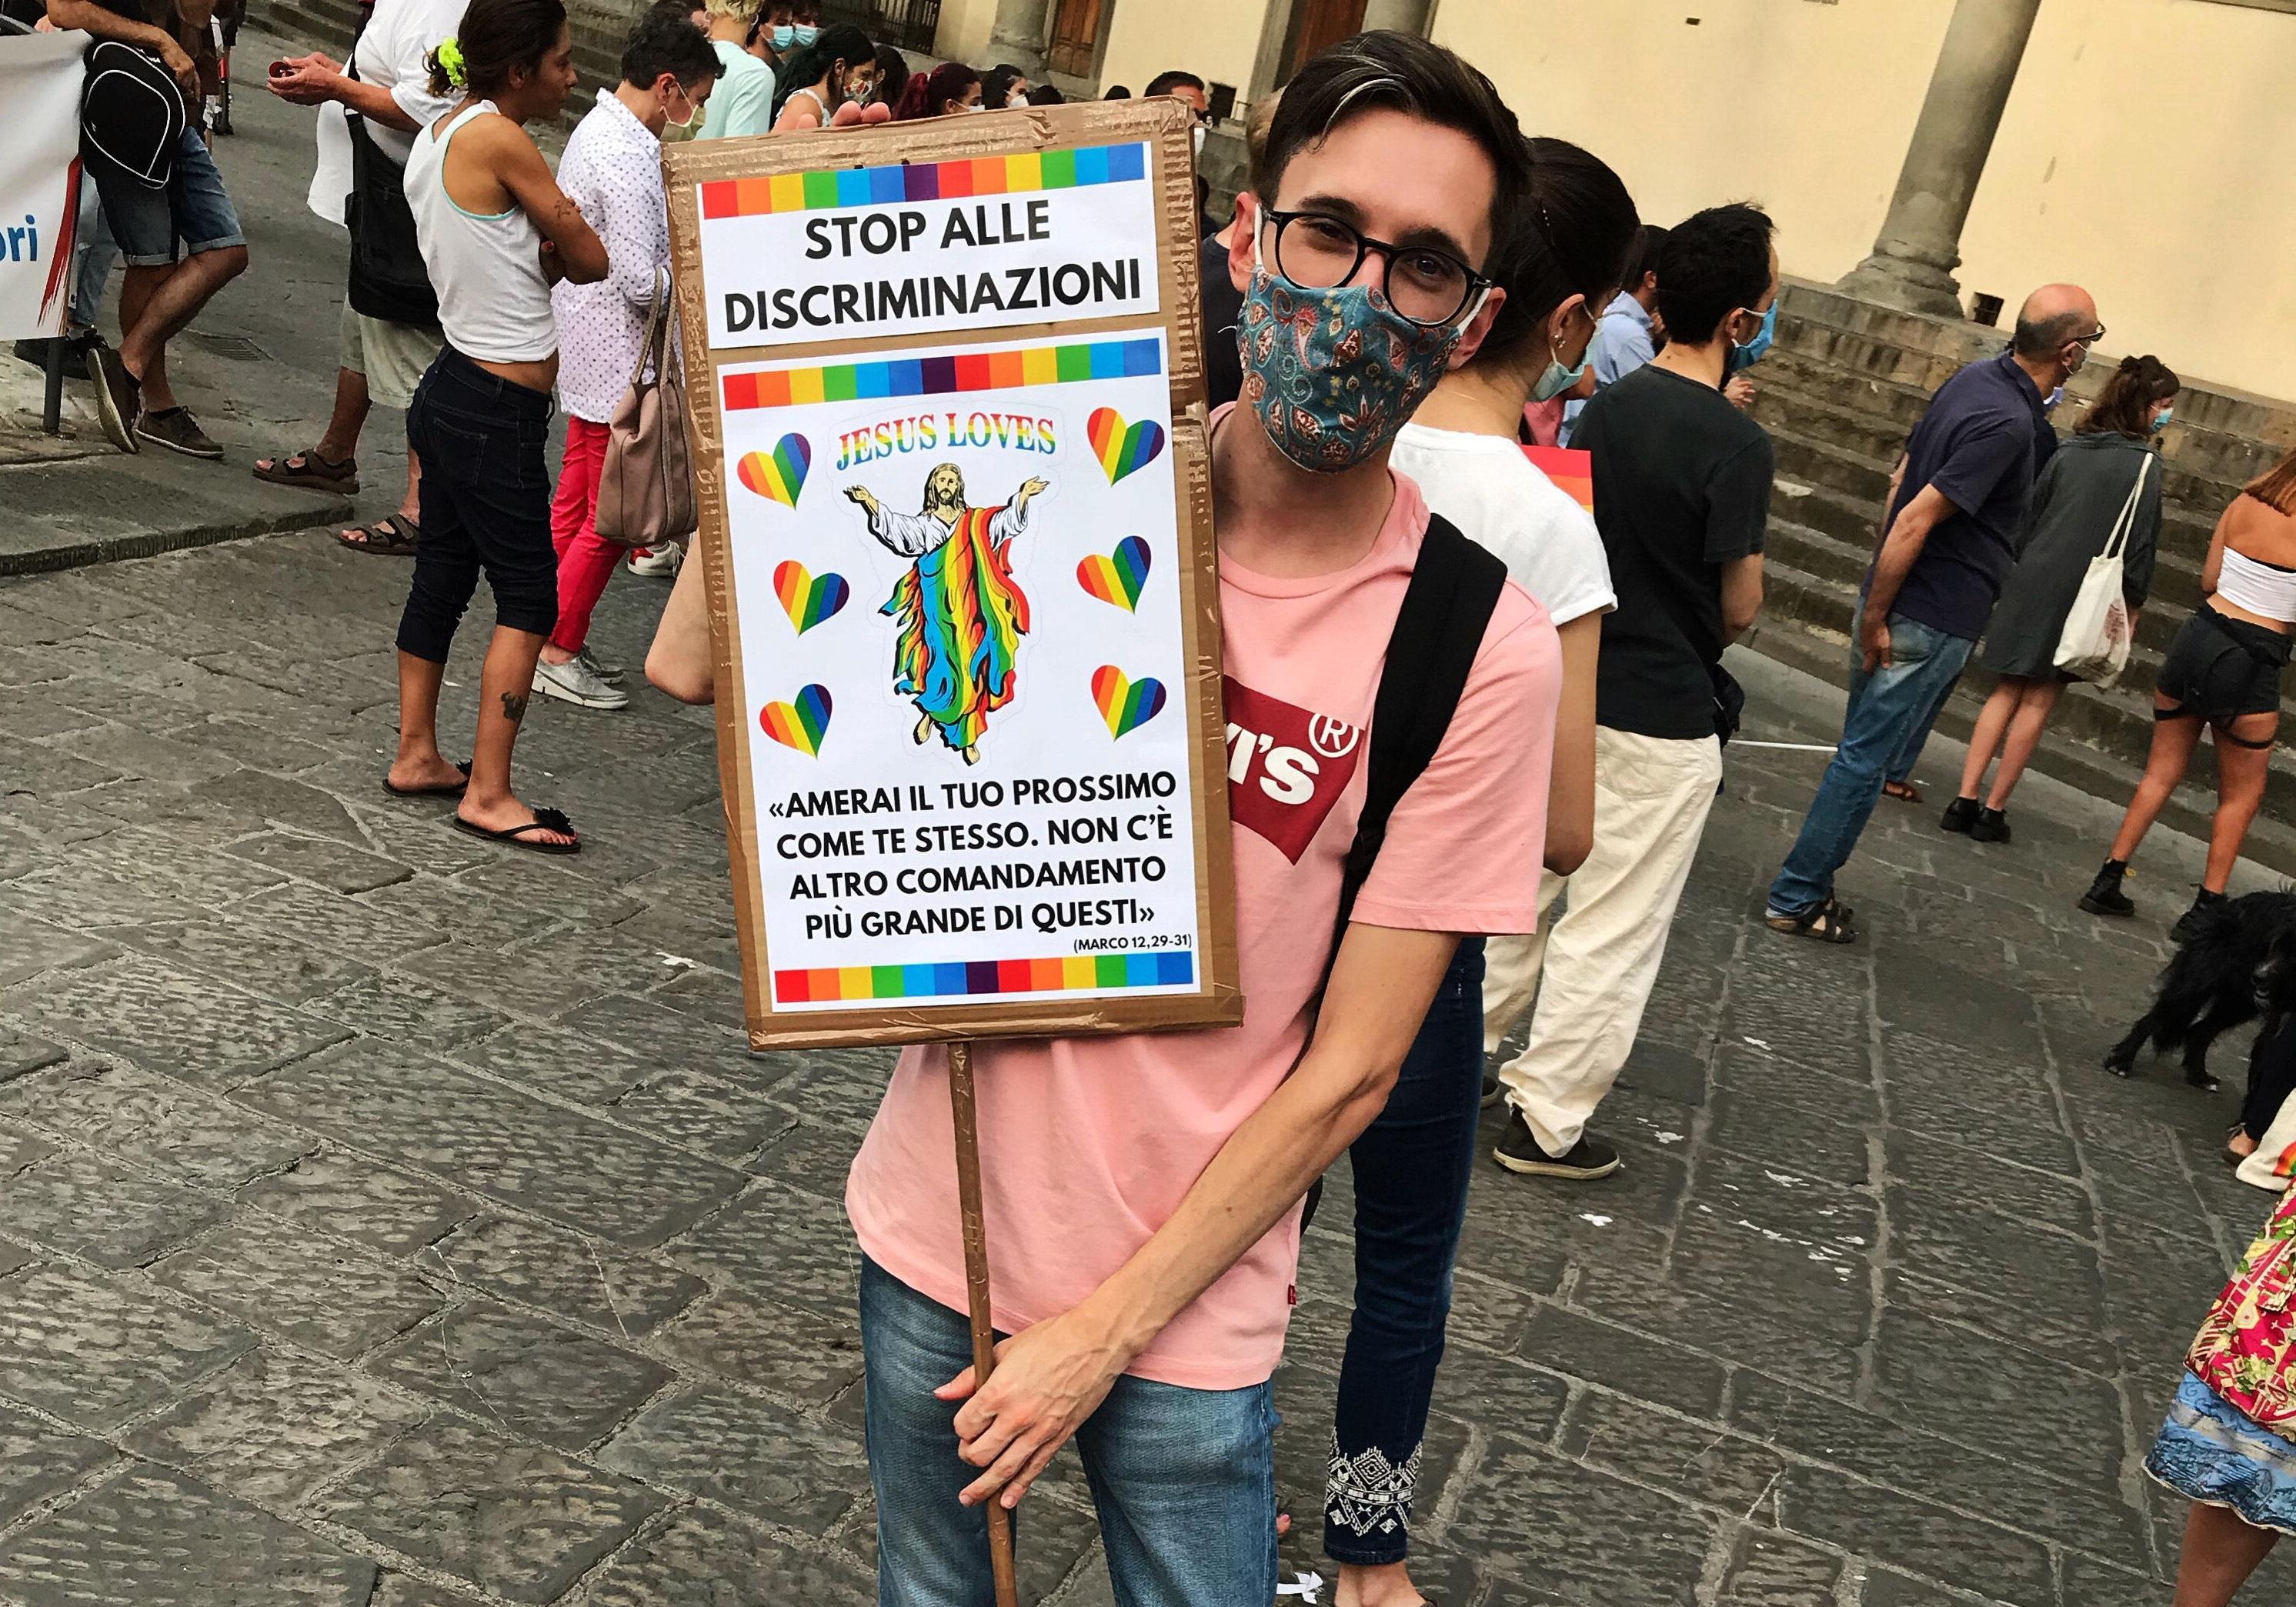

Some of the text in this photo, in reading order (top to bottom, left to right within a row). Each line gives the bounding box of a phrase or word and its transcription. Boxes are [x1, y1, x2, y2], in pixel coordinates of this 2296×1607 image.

[0, 215, 37, 262] ri
[805, 199, 1051, 260] STOP ALLE
[725, 258, 1140, 333] DISCRIMINAZIONI
[836, 412, 1056, 472] JESUS LOVES
[769, 771, 1176, 819] «AMERAI IL TUO PROSSIMO
[776, 804, 1173, 860] COME TE STESSO. NON C'È
[789, 855, 1166, 900] ALTRO COMANDAMENTO
[806, 899, 1155, 940] PIÙ GRANDE DI QUESTI»
[1073, 933, 1192, 954] (MARCO 12,29-31)
